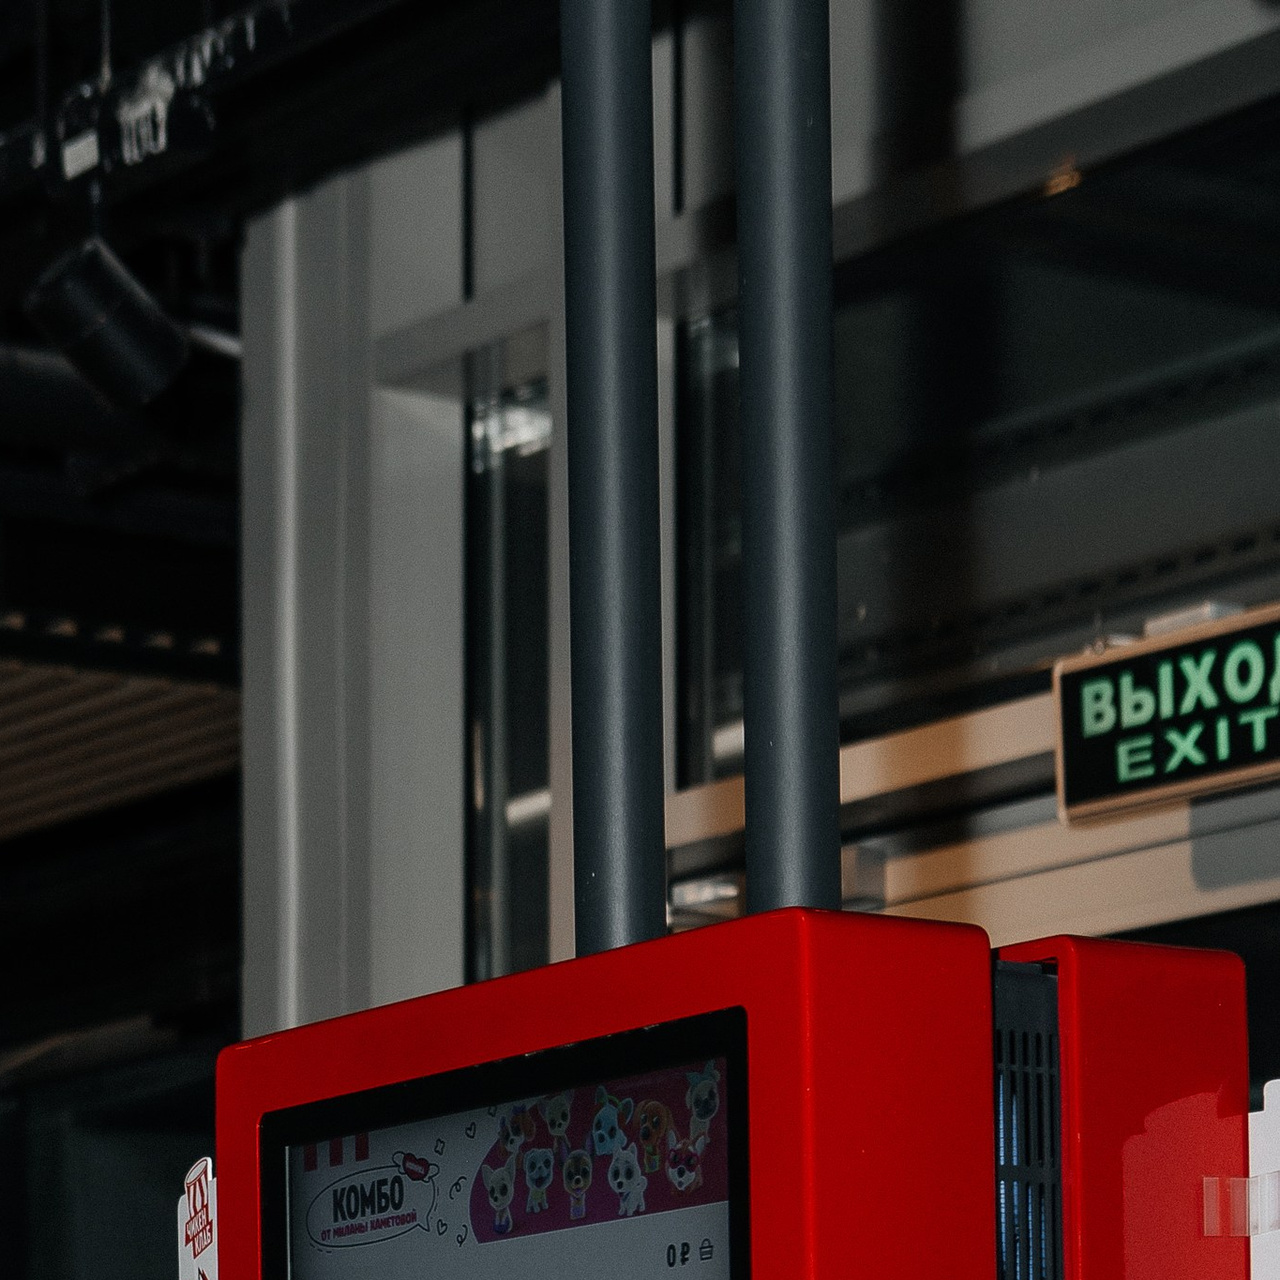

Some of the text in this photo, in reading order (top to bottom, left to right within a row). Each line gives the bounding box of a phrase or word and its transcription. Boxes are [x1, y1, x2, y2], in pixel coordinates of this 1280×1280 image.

[1082, 632, 1280, 739] ВЫХО
[1117, 705, 1279, 782] EXIT
[333, 1175, 404, 1223] КОМБО
[193, 1228, 212, 1256] КЛАБ
[321, 1228, 331, 1242] ОТ
[333, 1221, 368, 1239] МИЛАНЫ
